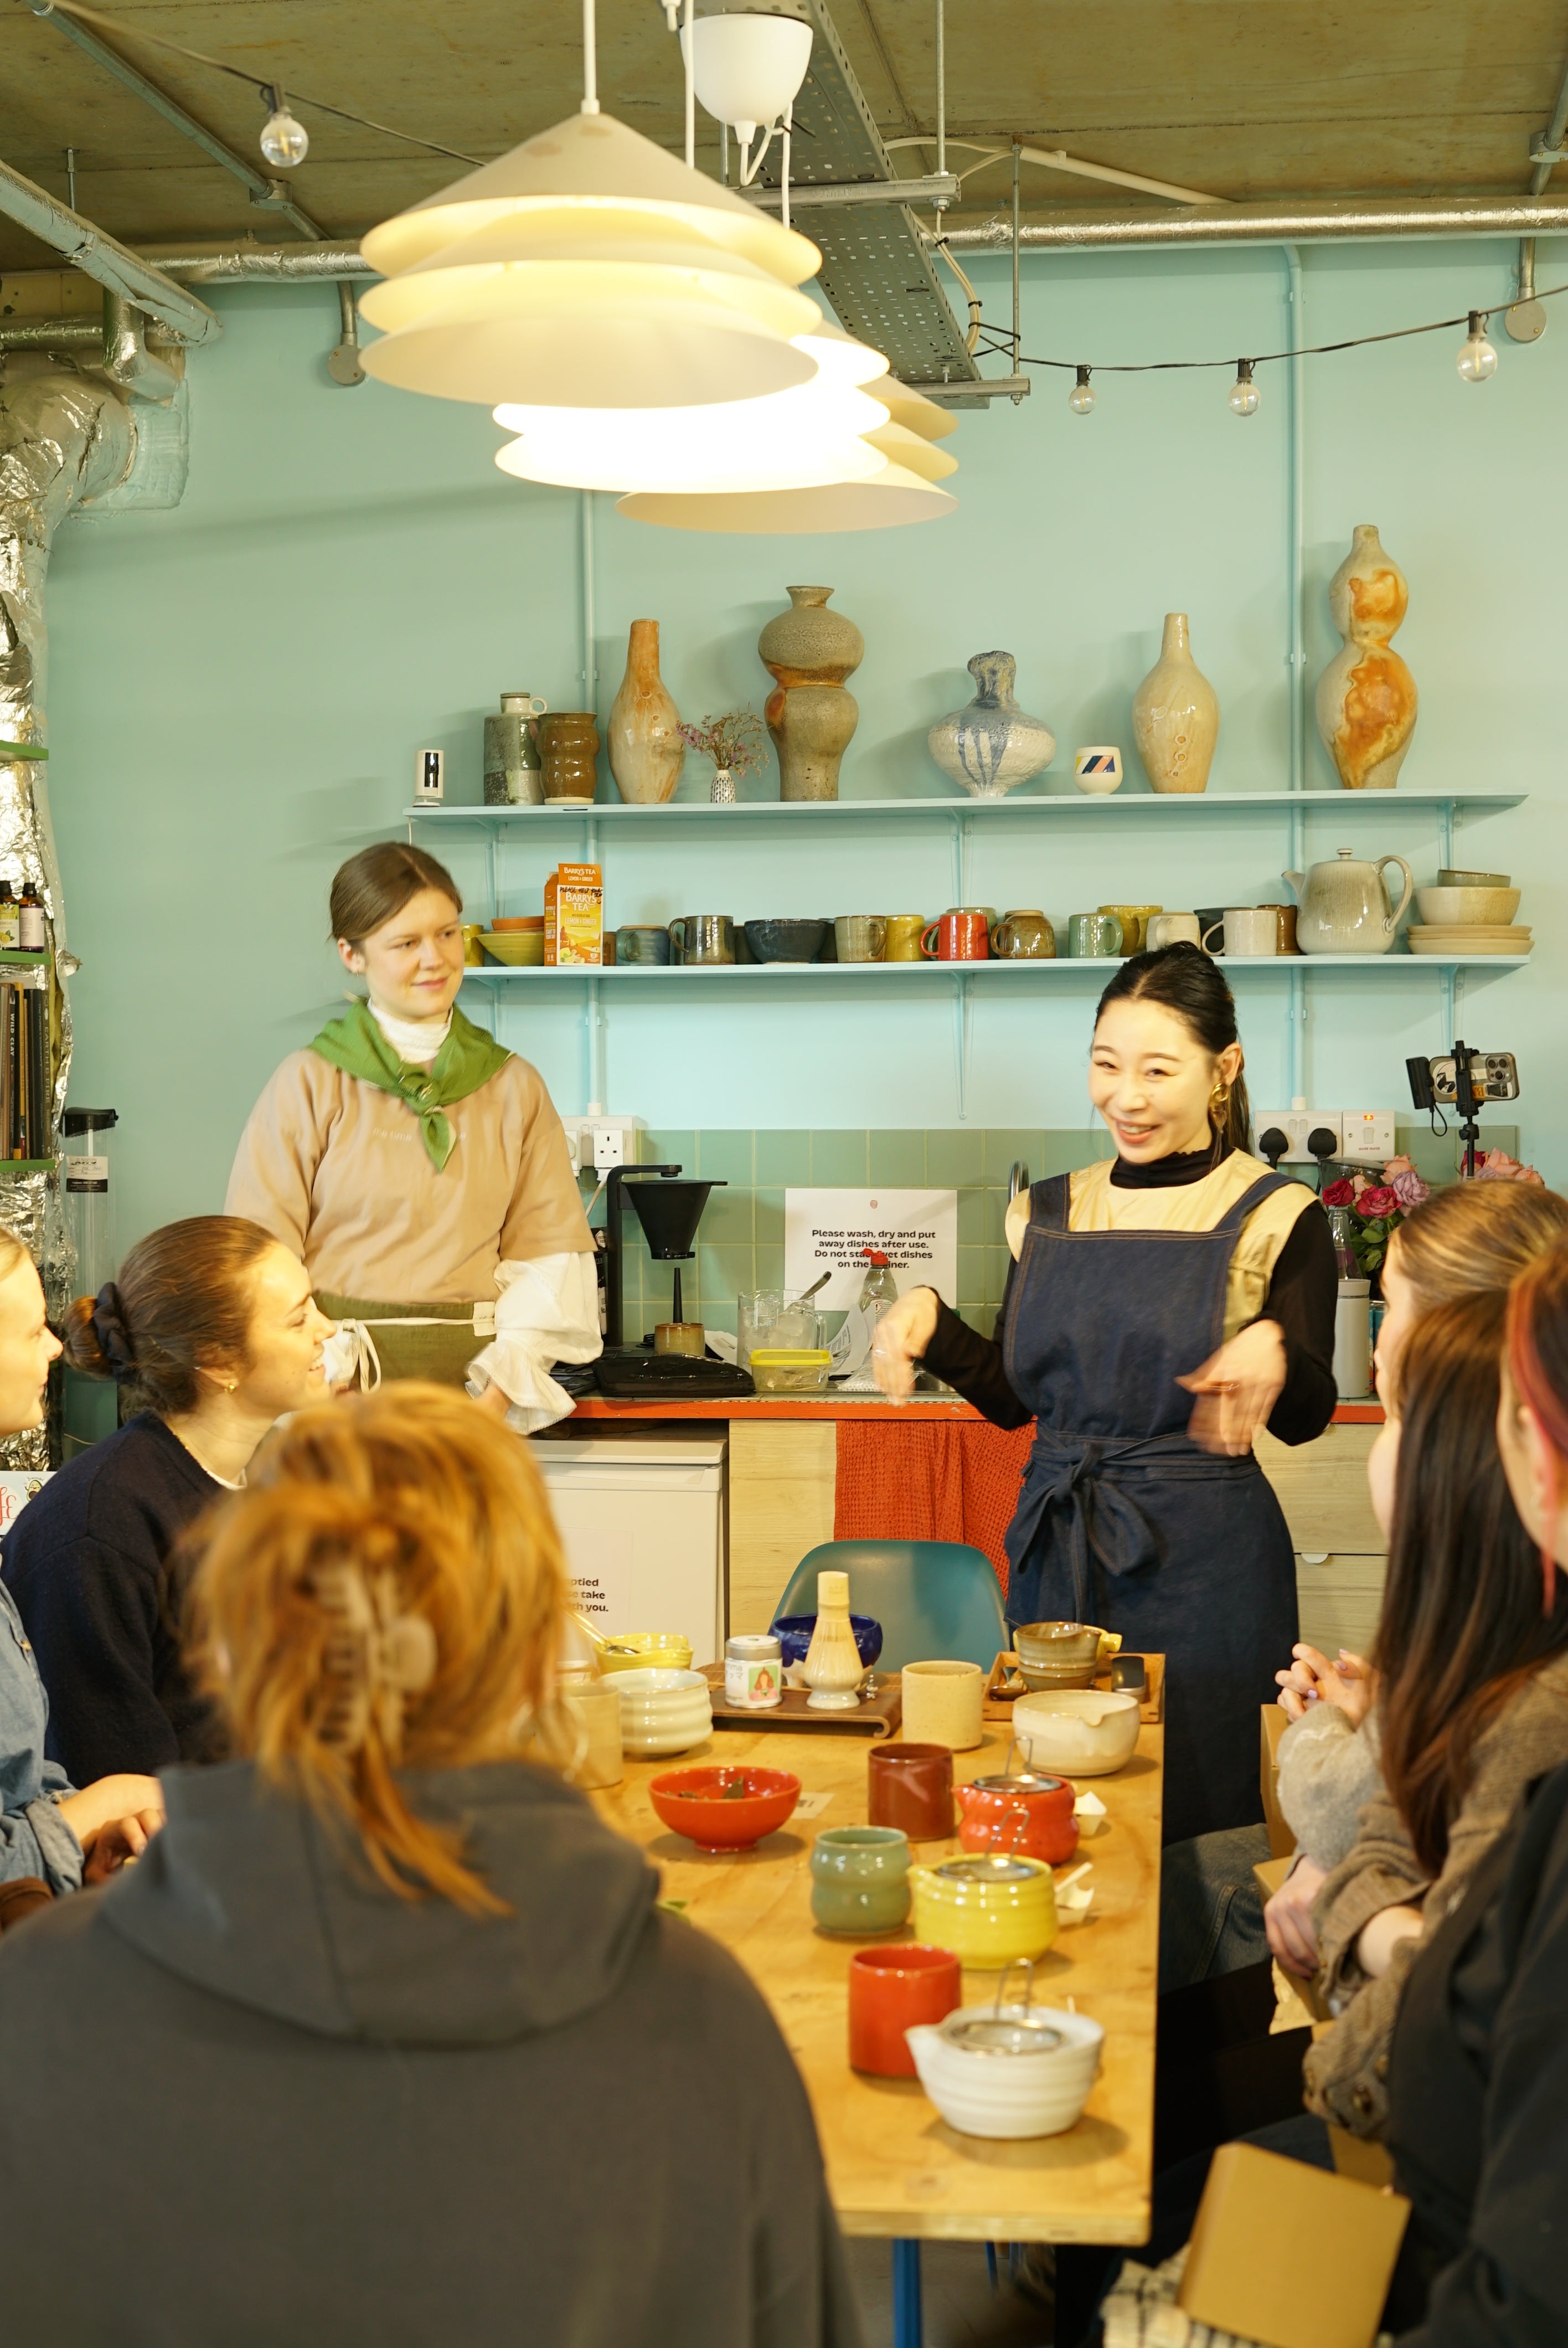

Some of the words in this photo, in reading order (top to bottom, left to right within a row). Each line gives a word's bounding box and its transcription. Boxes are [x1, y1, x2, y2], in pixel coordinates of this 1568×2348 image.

[572, 903, 589, 911] TEA
[878, 1230, 895, 1239] dry
[900, 1250, 933, 1259] dishes
[571, 1578, 599, 1587] ptied
[581, 1591, 605, 1599] take
